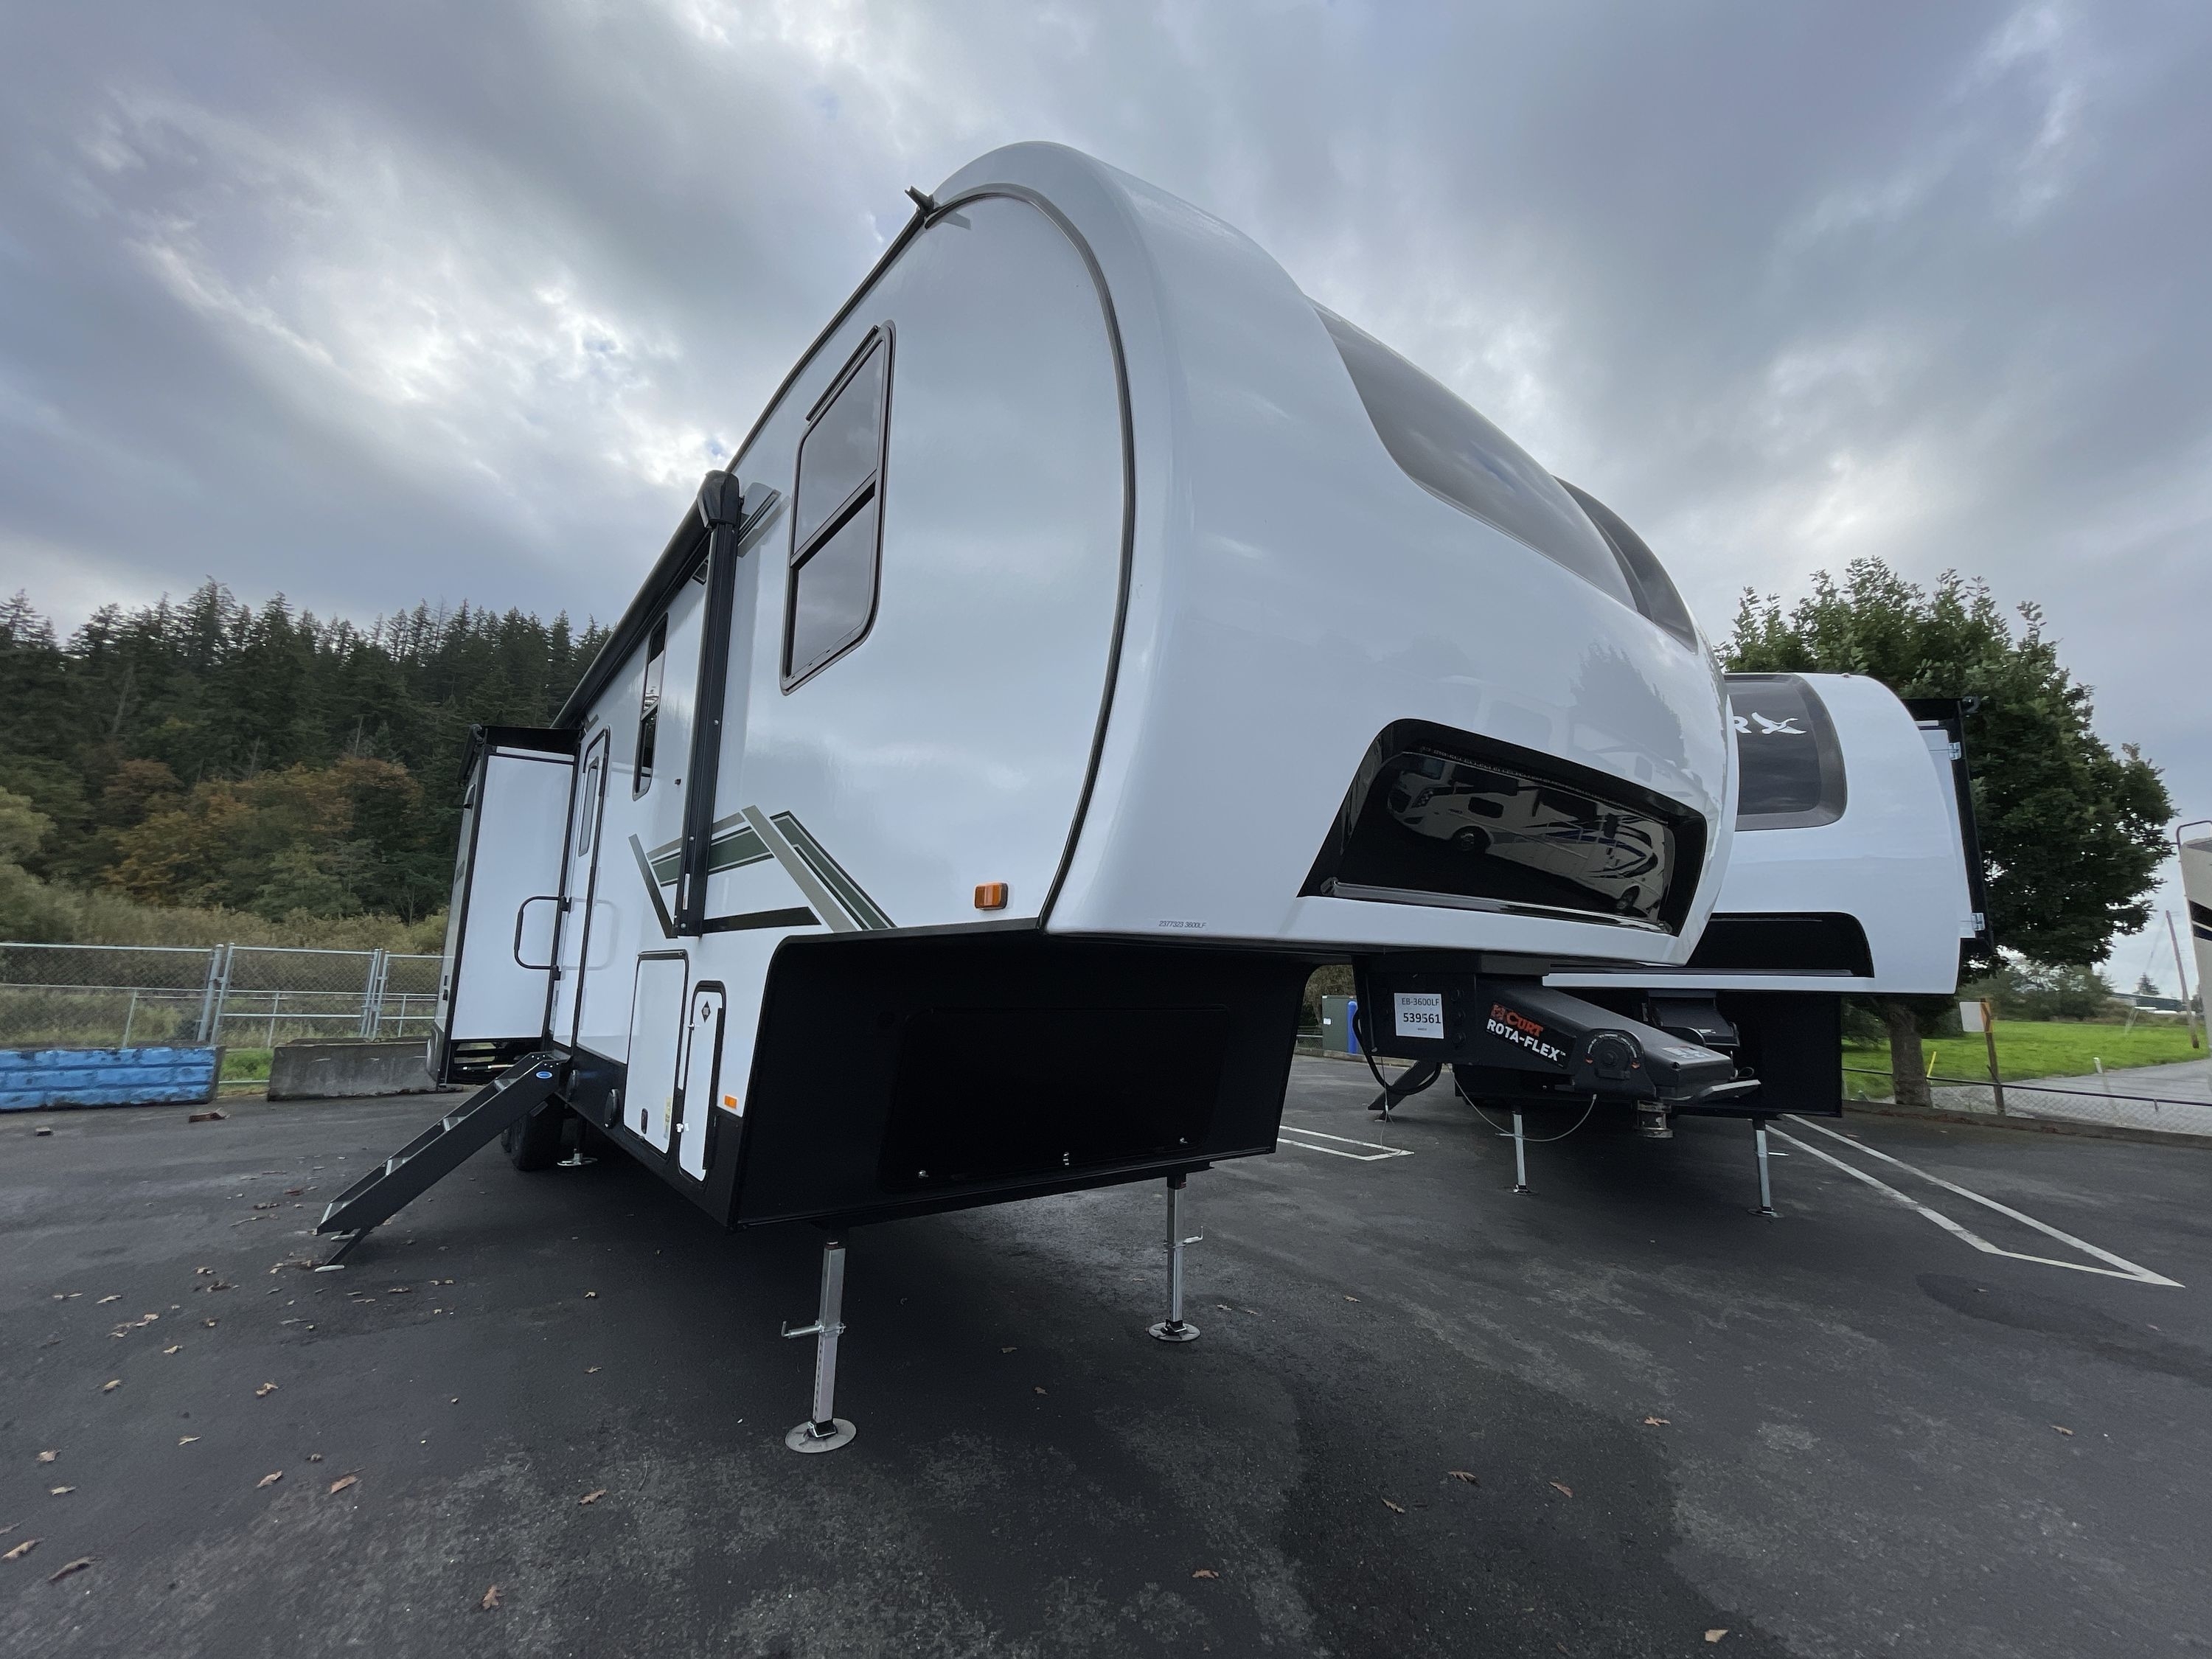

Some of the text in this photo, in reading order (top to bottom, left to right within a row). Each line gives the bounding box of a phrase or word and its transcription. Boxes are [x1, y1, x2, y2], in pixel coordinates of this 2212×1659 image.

[1184, 921, 1207, 929] 3600LF
[1402, 998, 1439, 1006] EB-3600LF
[1403, 1012, 1441, 1024] 539561
